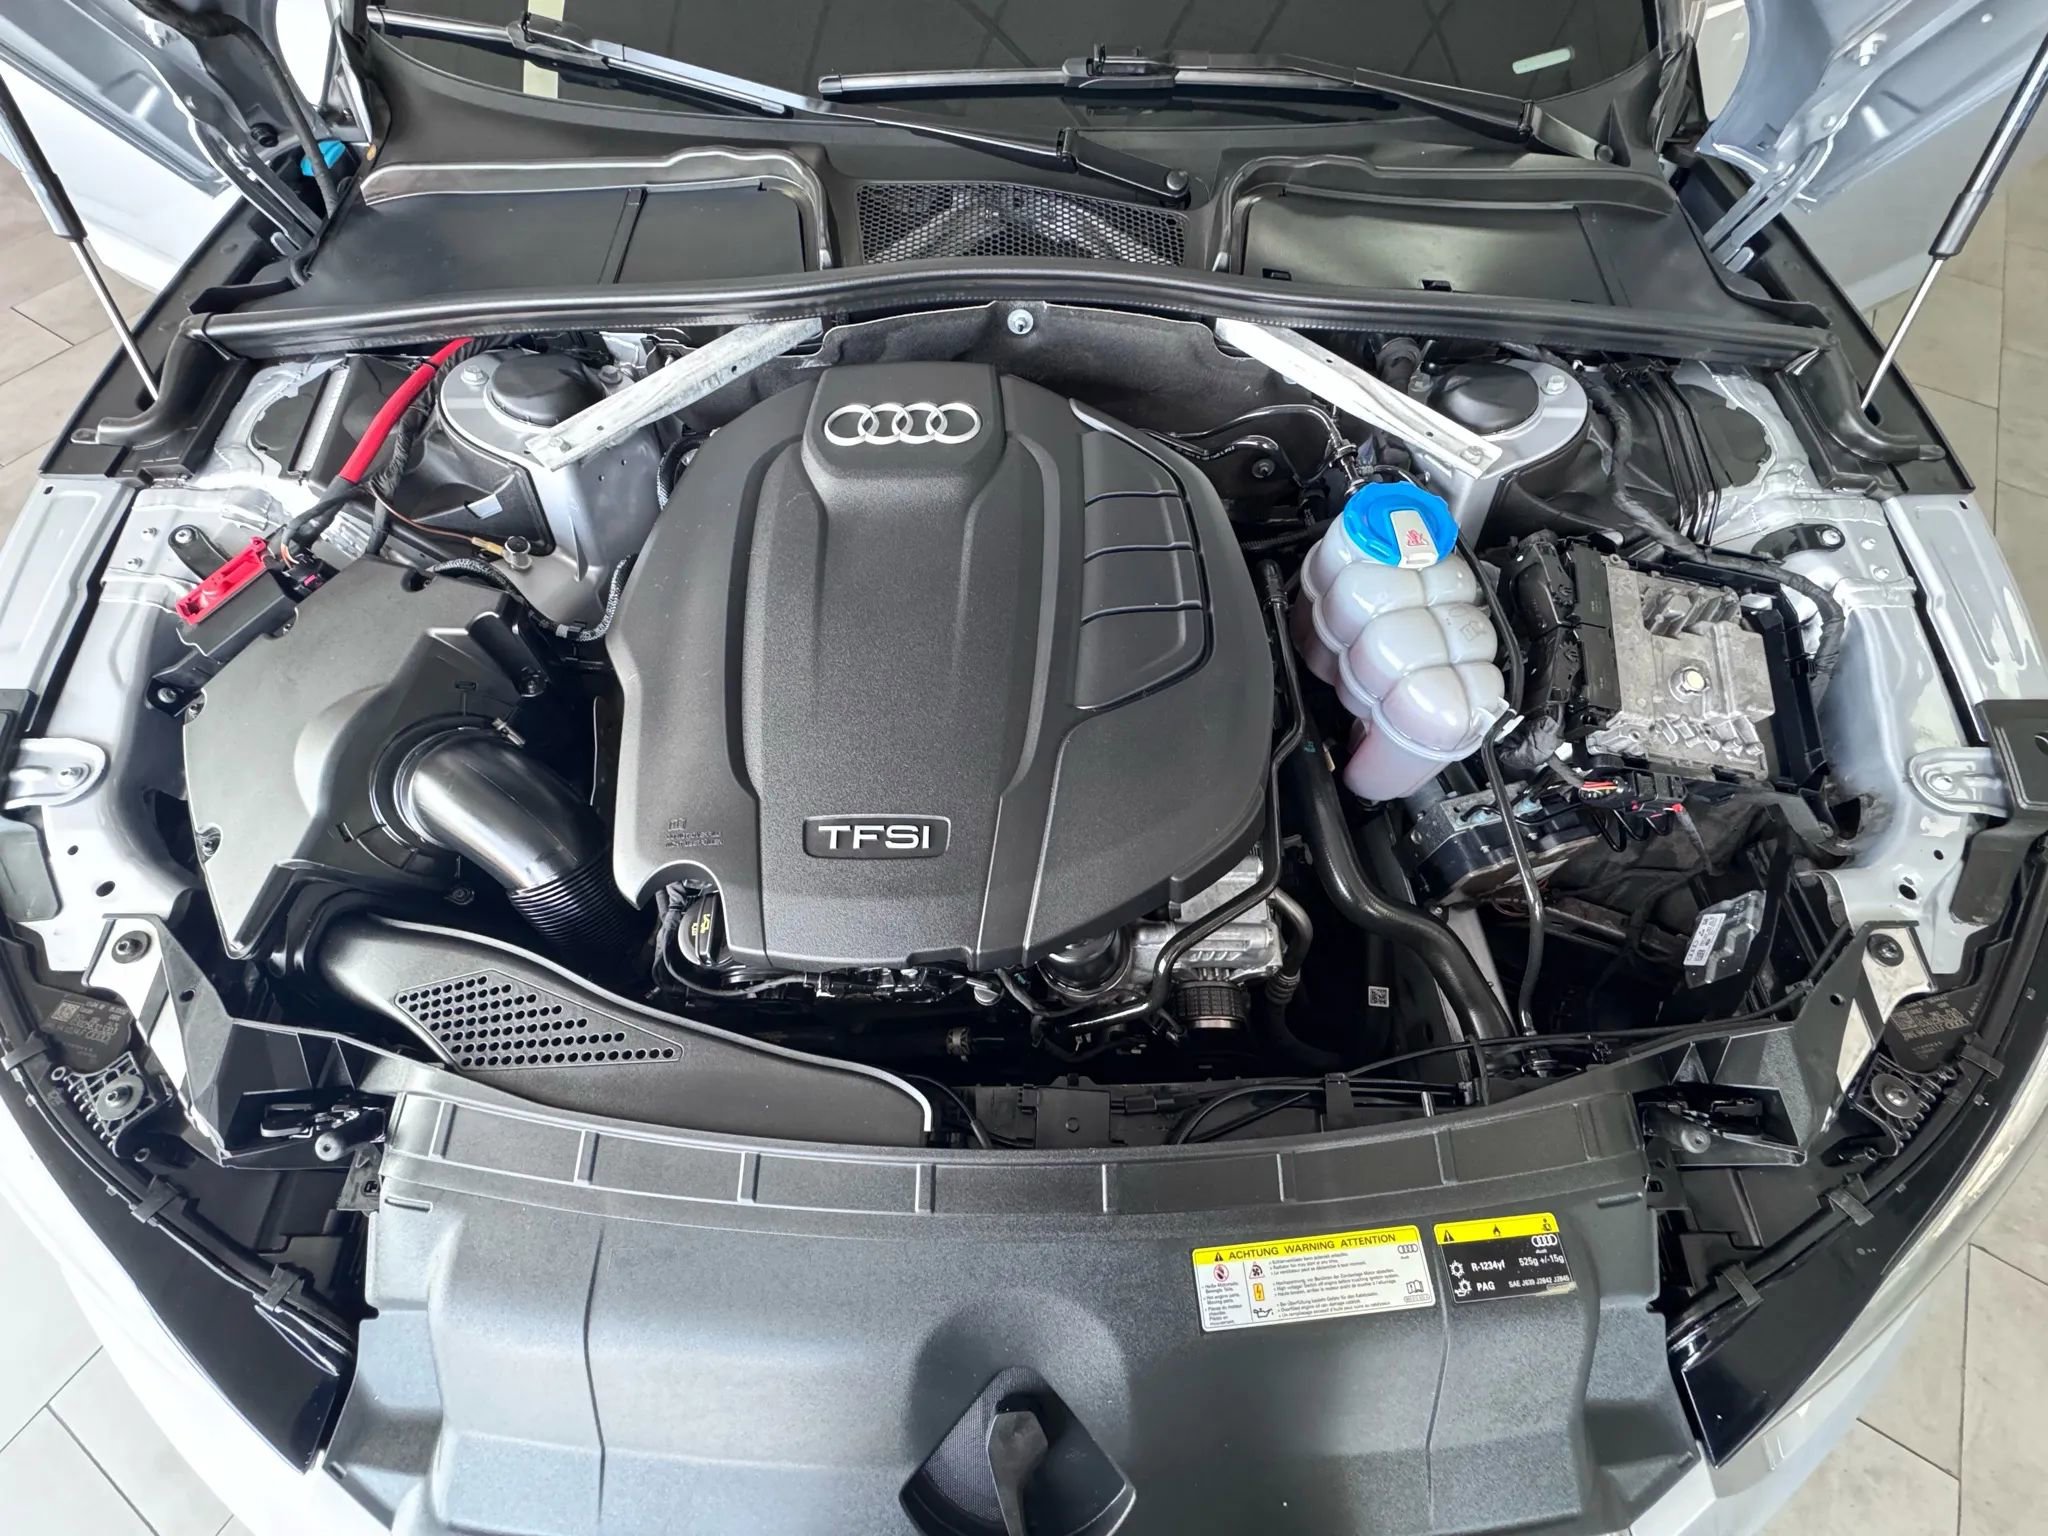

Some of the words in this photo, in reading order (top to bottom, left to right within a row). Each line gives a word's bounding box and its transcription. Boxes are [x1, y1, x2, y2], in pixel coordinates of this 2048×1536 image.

[818, 825, 930, 850] TFSI
[1228, 1247, 1279, 1260] ACHTUNG
[1284, 1240, 1335, 1254] WARNING
[1340, 1233, 1396, 1248] ATTENTION
[1471, 1259, 1506, 1272] R-1234yf
[1518, 1256, 1539, 1267] 525g
[1540, 1254, 1565, 1264] +/-15g
[1476, 1281, 1496, 1291] PAG
[1508, 1280, 1521, 1288] SAE
